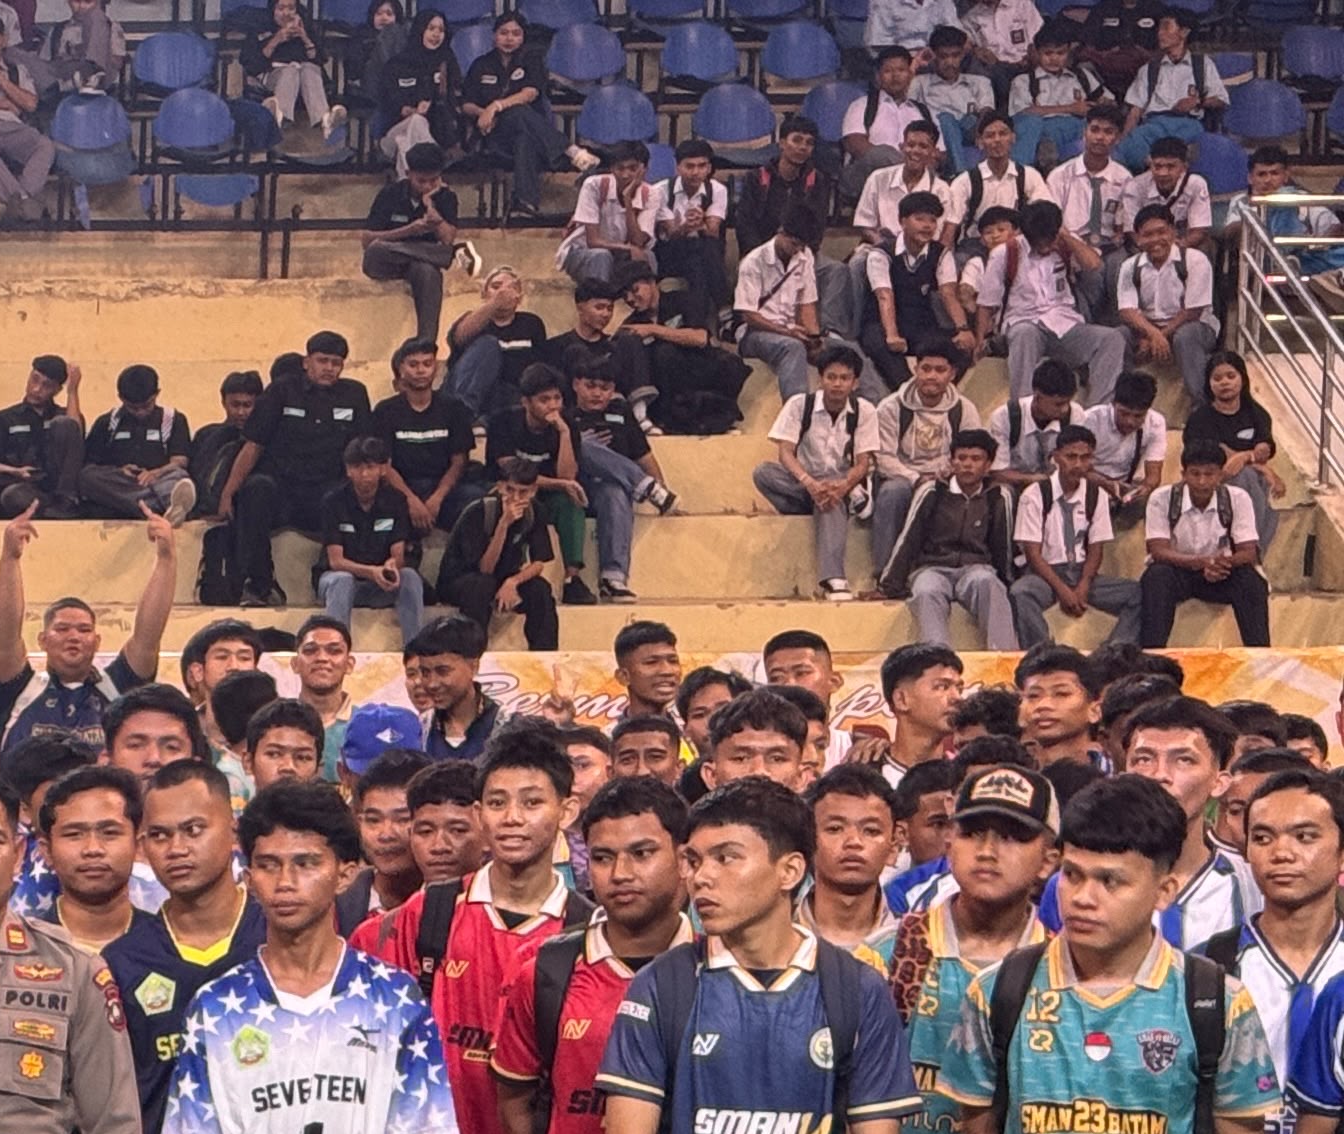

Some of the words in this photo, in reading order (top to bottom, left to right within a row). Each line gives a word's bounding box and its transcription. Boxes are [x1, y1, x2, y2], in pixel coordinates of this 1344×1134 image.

[5, 990, 67, 1011] POLRI
[1027, 986, 1061, 1021] 12
[251, 1073, 367, 1113] SEVETEEN
[1021, 1104, 1073, 1134] SMAN
[1074, 1100, 1107, 1133] 23
